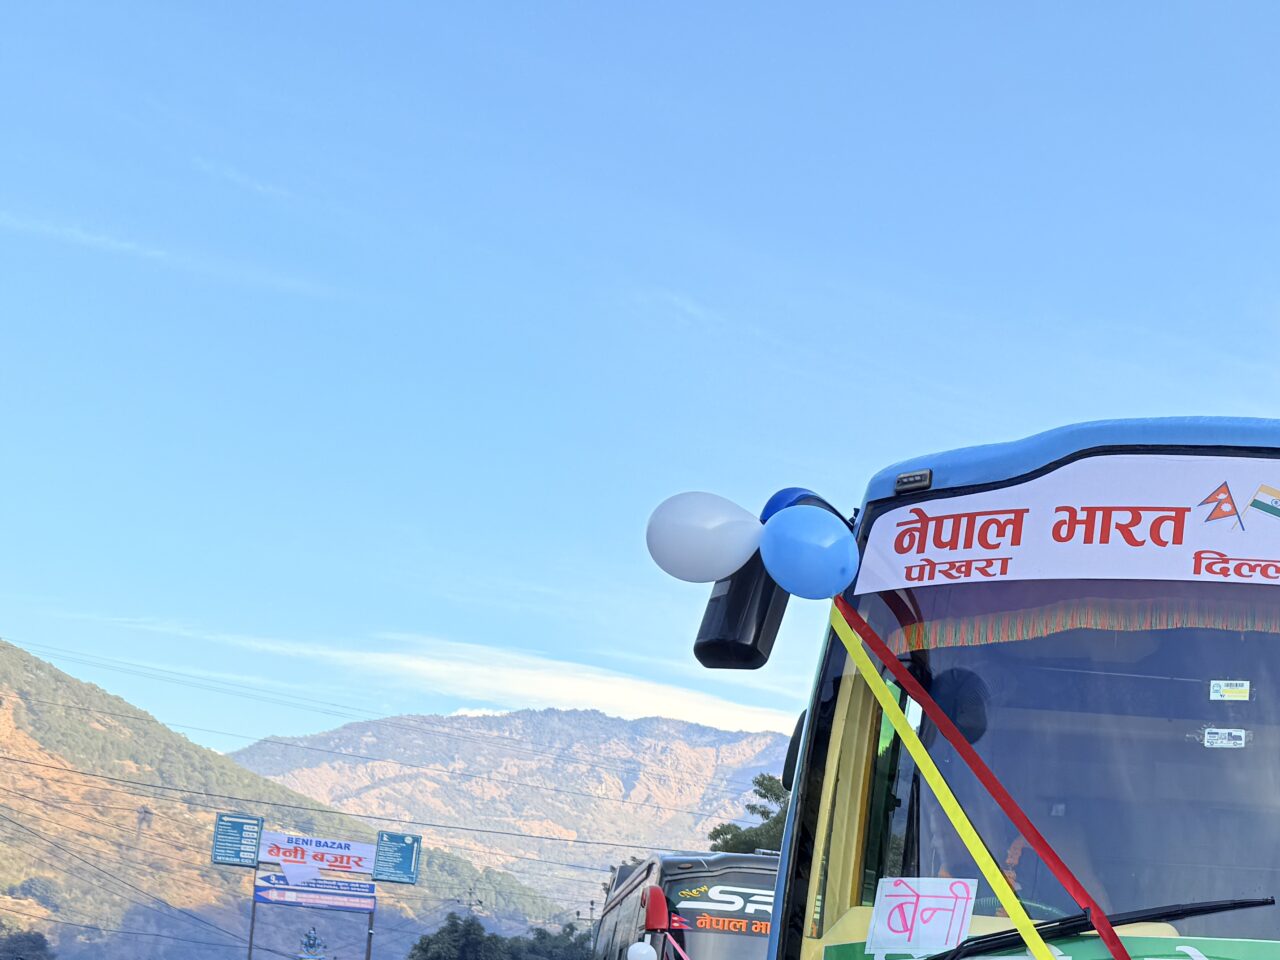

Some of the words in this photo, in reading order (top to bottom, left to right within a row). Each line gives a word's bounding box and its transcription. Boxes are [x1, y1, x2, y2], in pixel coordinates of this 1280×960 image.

[894, 507, 1029, 555] नेपाल
[1053, 505, 1191, 547] भारत
[904, 557, 1012, 582] पोखरा
[267, 843, 308, 861] बेनी
[286, 836, 313, 847] BENI
[314, 838, 351, 851] BAZAR
[696, 912, 749, 932] नेपाल
[885, 878, 972, 946] बेनी
